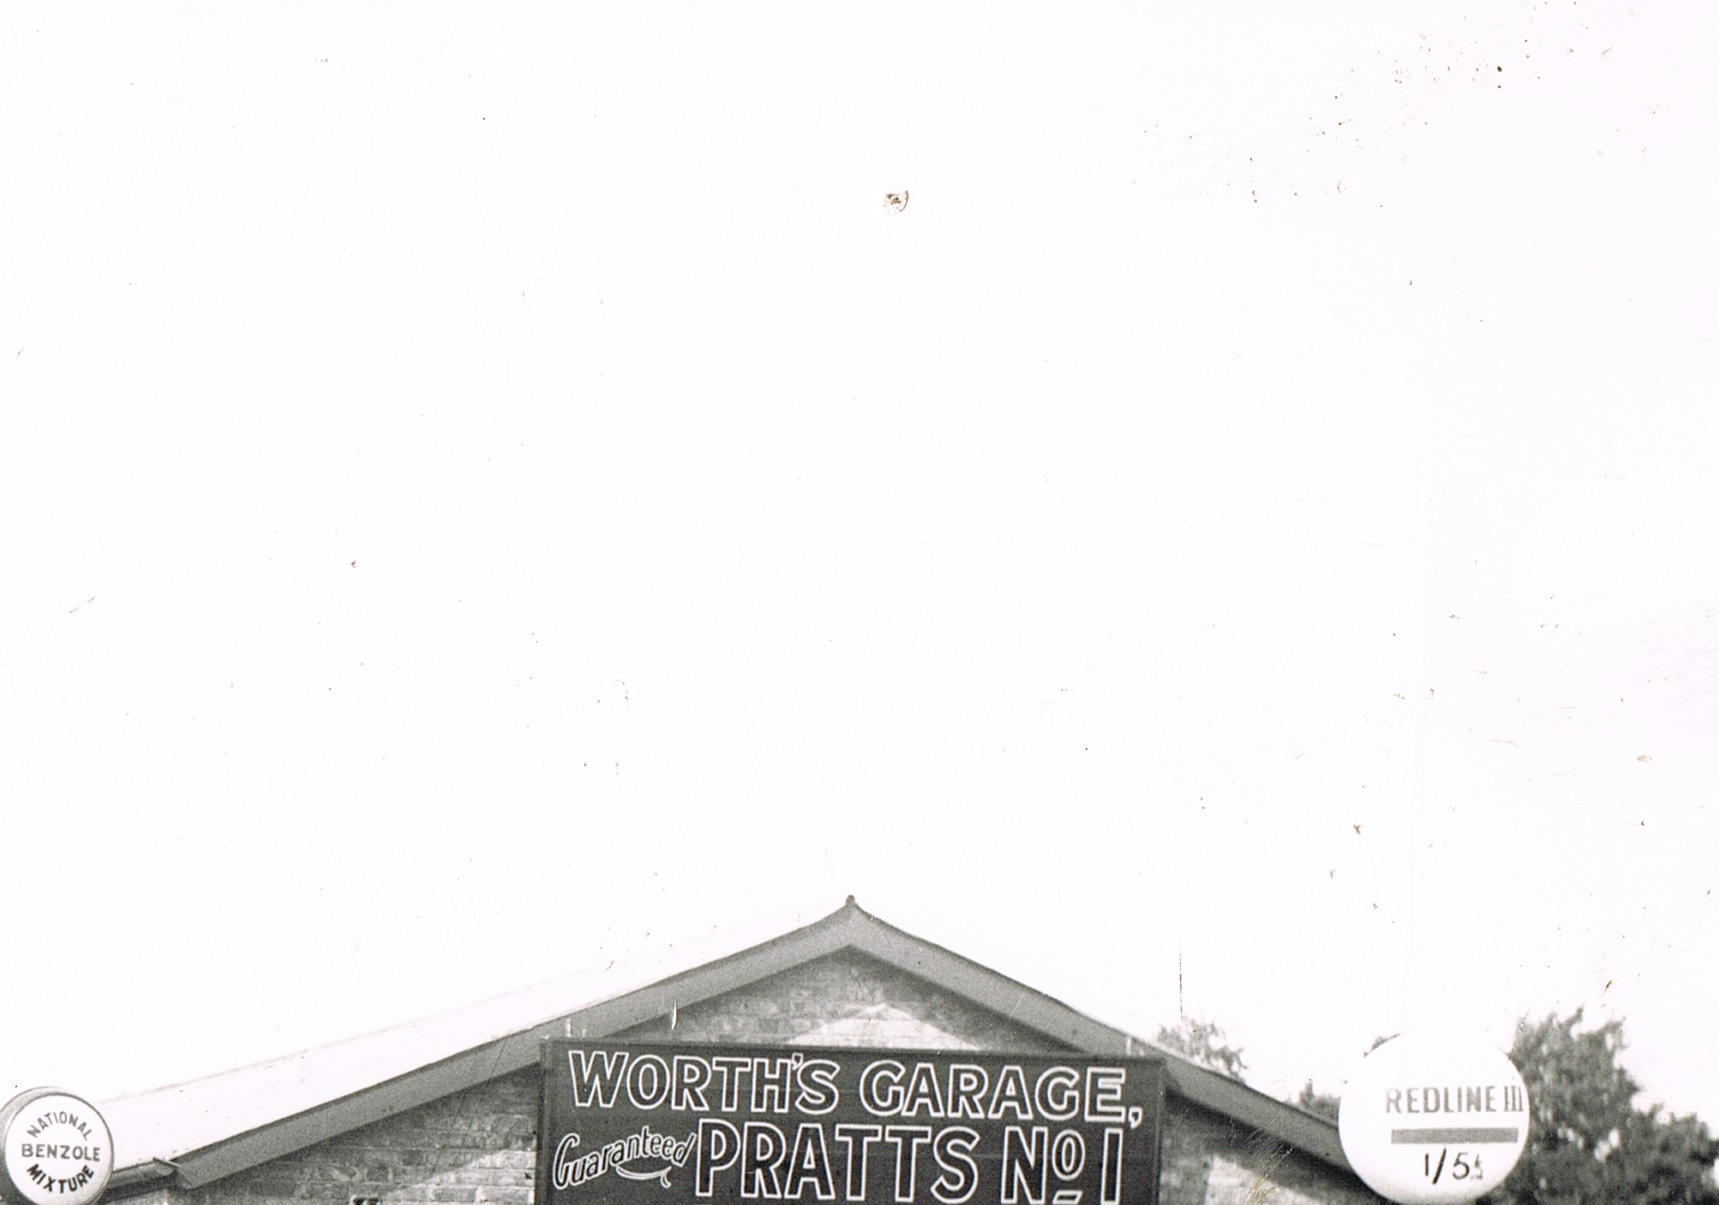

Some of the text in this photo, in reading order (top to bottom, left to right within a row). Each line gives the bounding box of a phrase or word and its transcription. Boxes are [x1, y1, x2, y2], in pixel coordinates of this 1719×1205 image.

[568, 1050, 1144, 1130] WORTH'S GARAGE,
[1385, 1085, 1497, 1114] REDLINE
[26, 1111, 94, 1142] NATIONAL
[21, 1143, 101, 1163] BENZOLE
[553, 1125, 698, 1191] Guaranteed
[26, 1163, 95, 1195] MIXTURE
